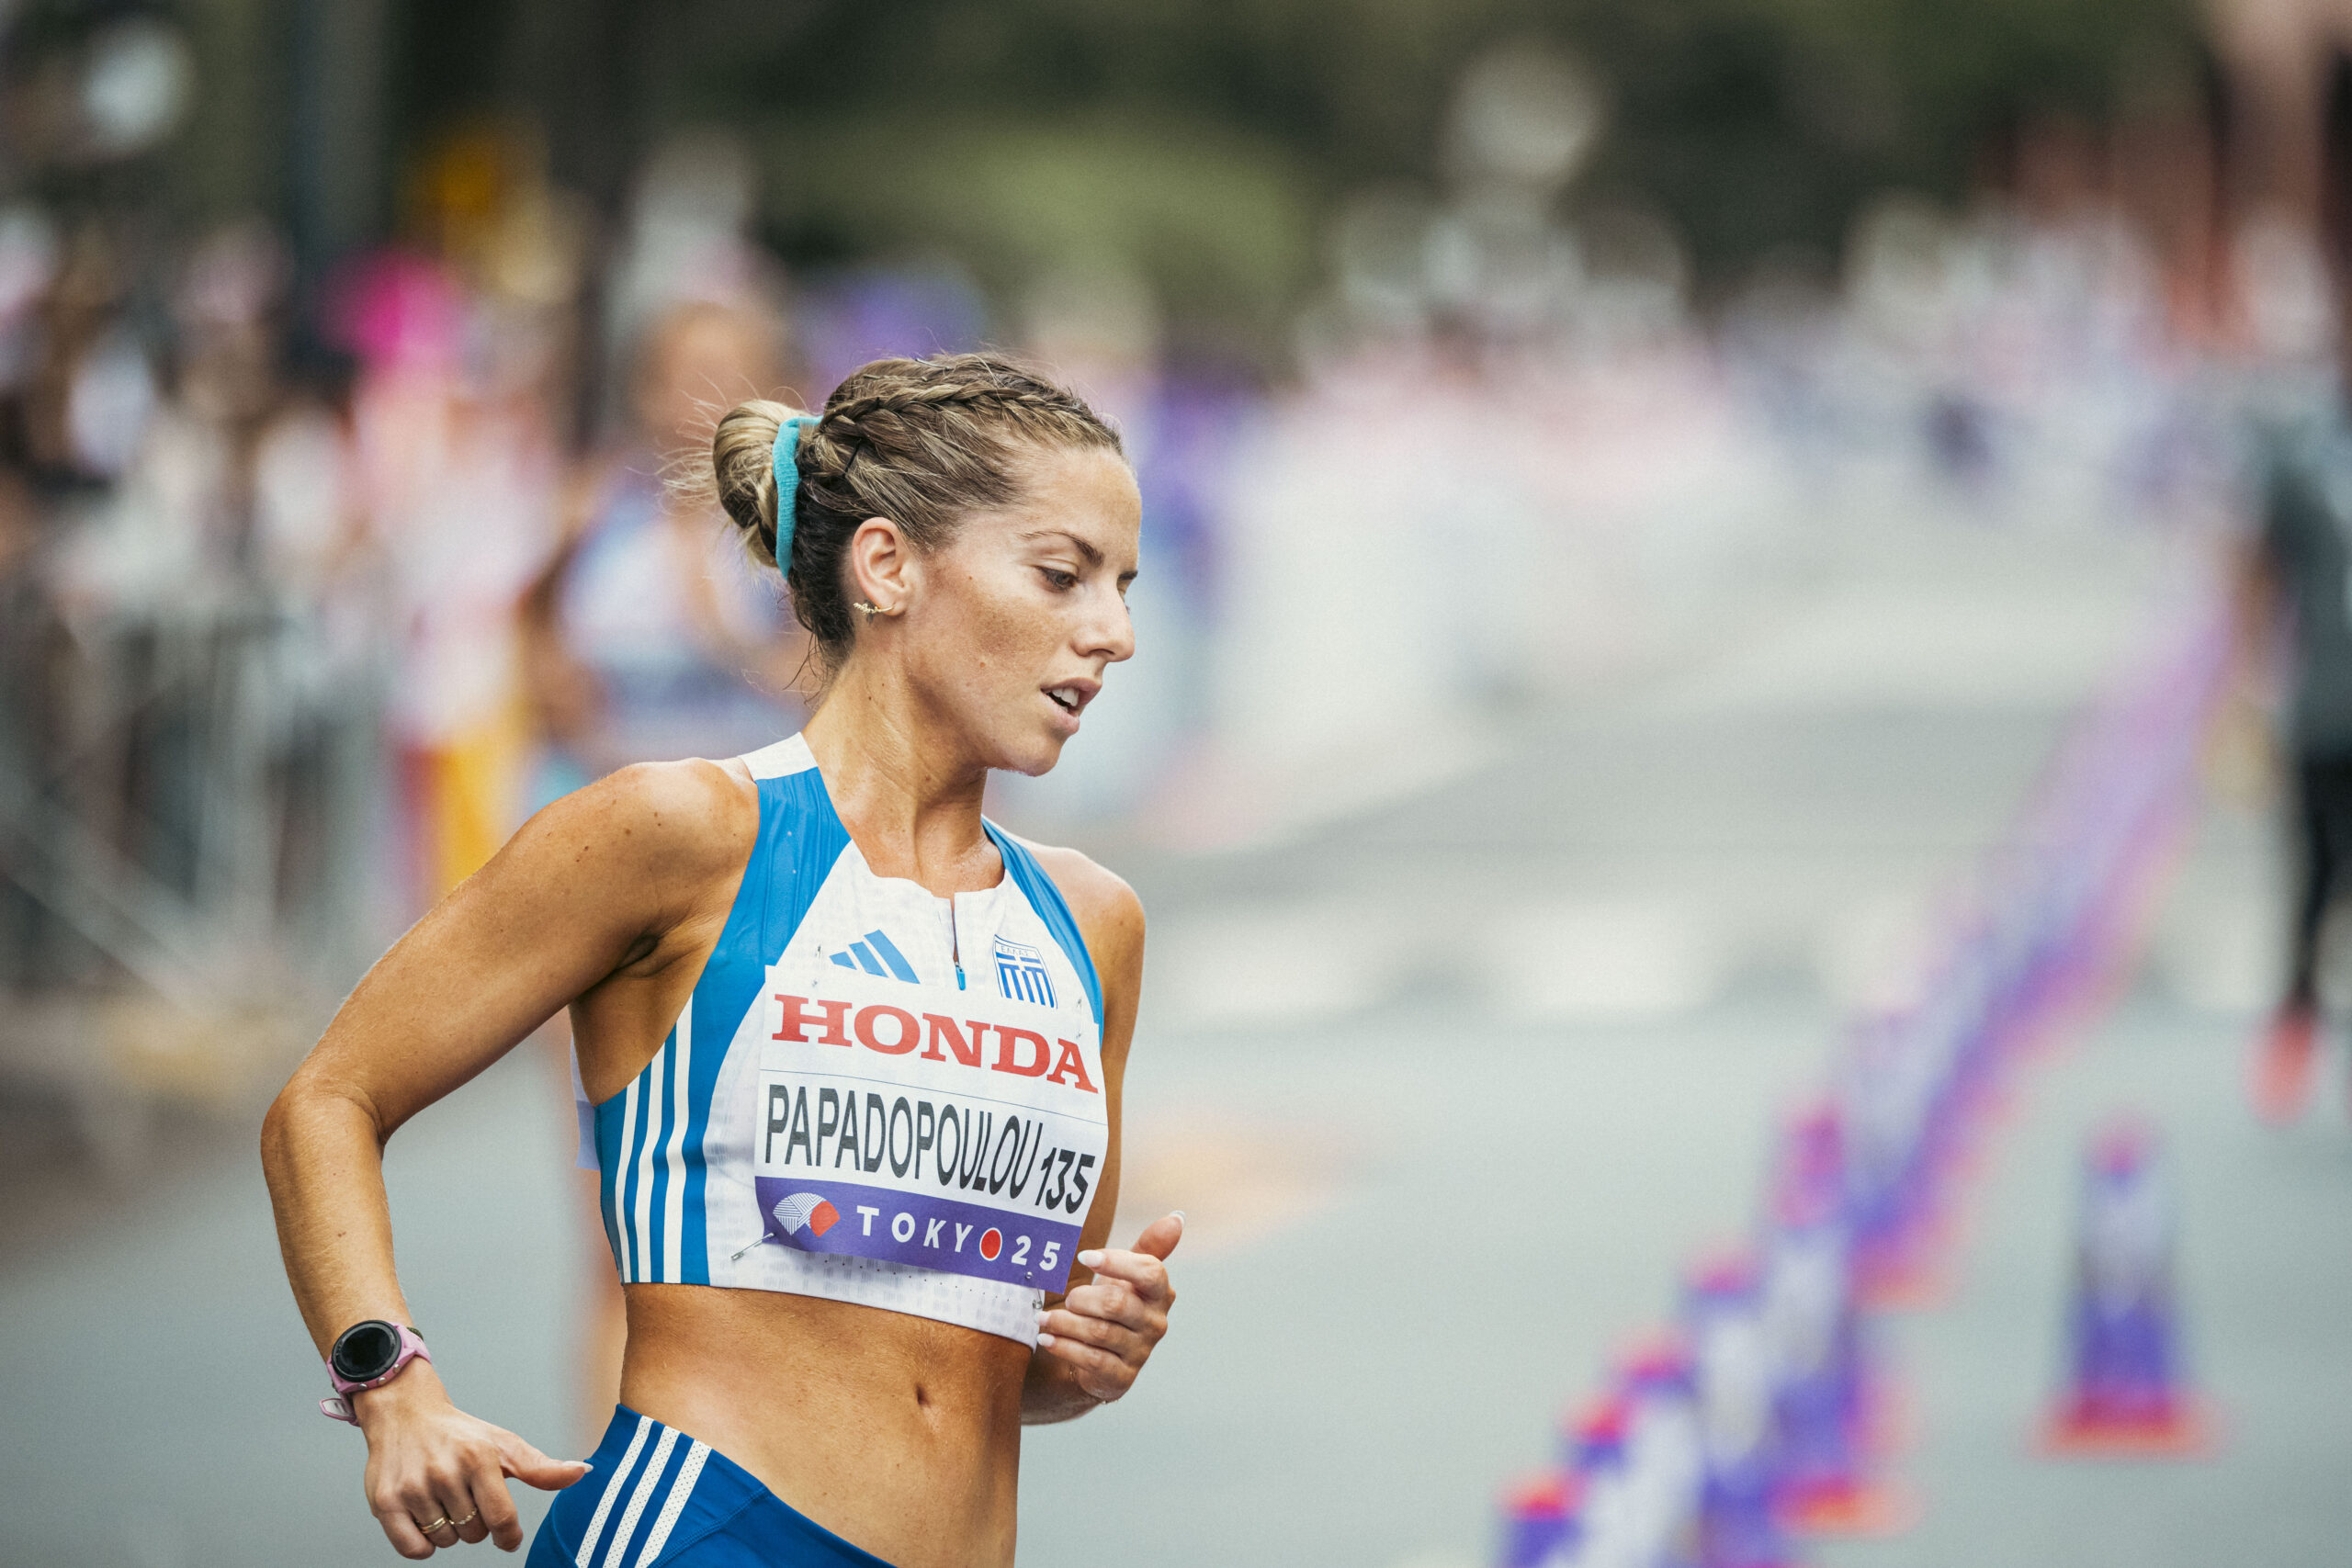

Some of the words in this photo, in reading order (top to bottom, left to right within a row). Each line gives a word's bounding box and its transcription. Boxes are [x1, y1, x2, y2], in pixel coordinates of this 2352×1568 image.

[772, 994, 1099, 1094] HONDA
[764, 1084, 1044, 1200] PAPADOPOULOU
[1035, 1147, 1096, 1214] 135
[856, 1204, 1003, 1262] TOKYO
[1011, 1235, 1061, 1271] 25
